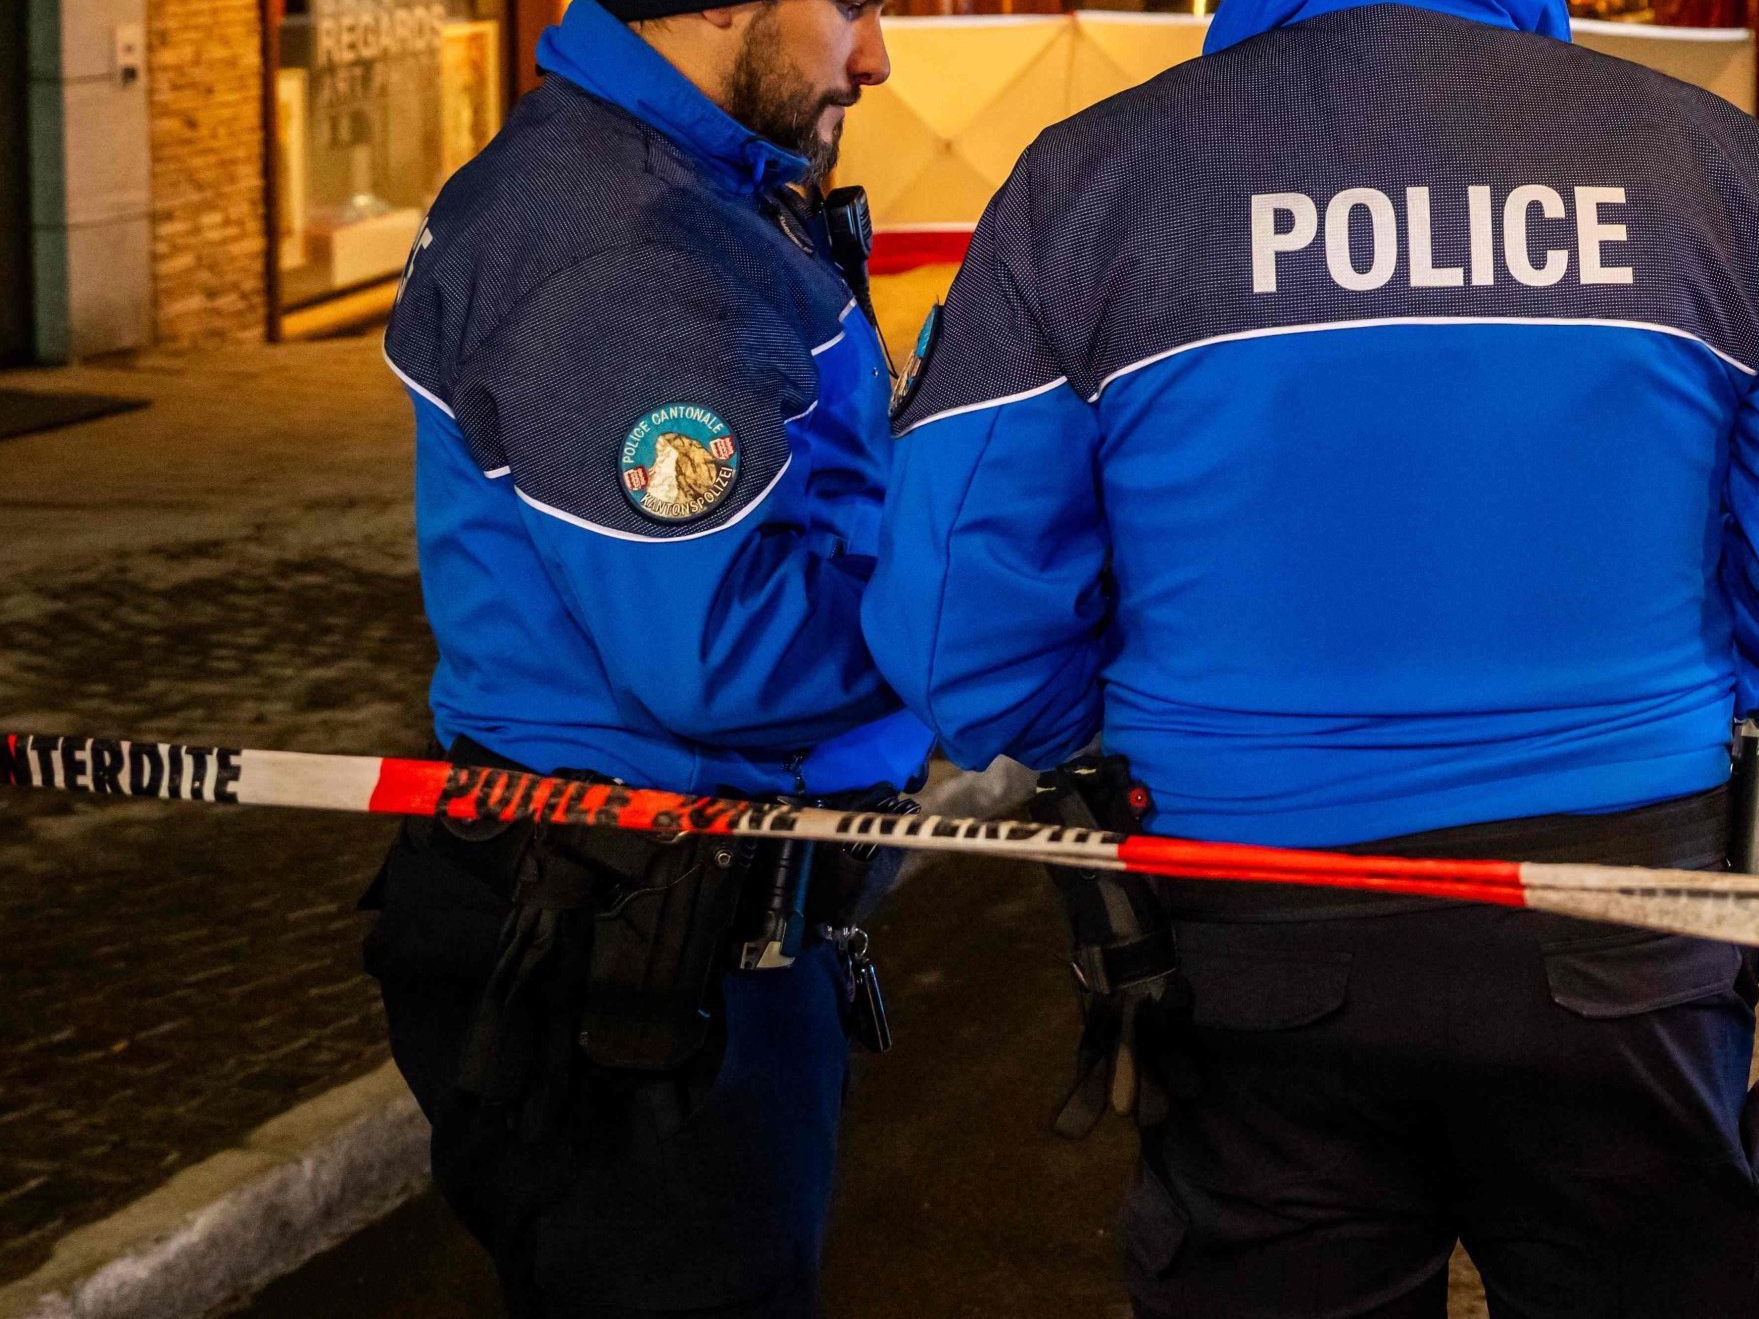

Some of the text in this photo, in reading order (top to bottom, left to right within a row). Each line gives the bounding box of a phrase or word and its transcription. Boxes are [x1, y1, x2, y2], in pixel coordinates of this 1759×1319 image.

[1250, 184, 1634, 294] POLICE
[622, 405, 725, 464] POLICE CANTONALE
[639, 465, 734, 517] KANTONSPOLIZEI
